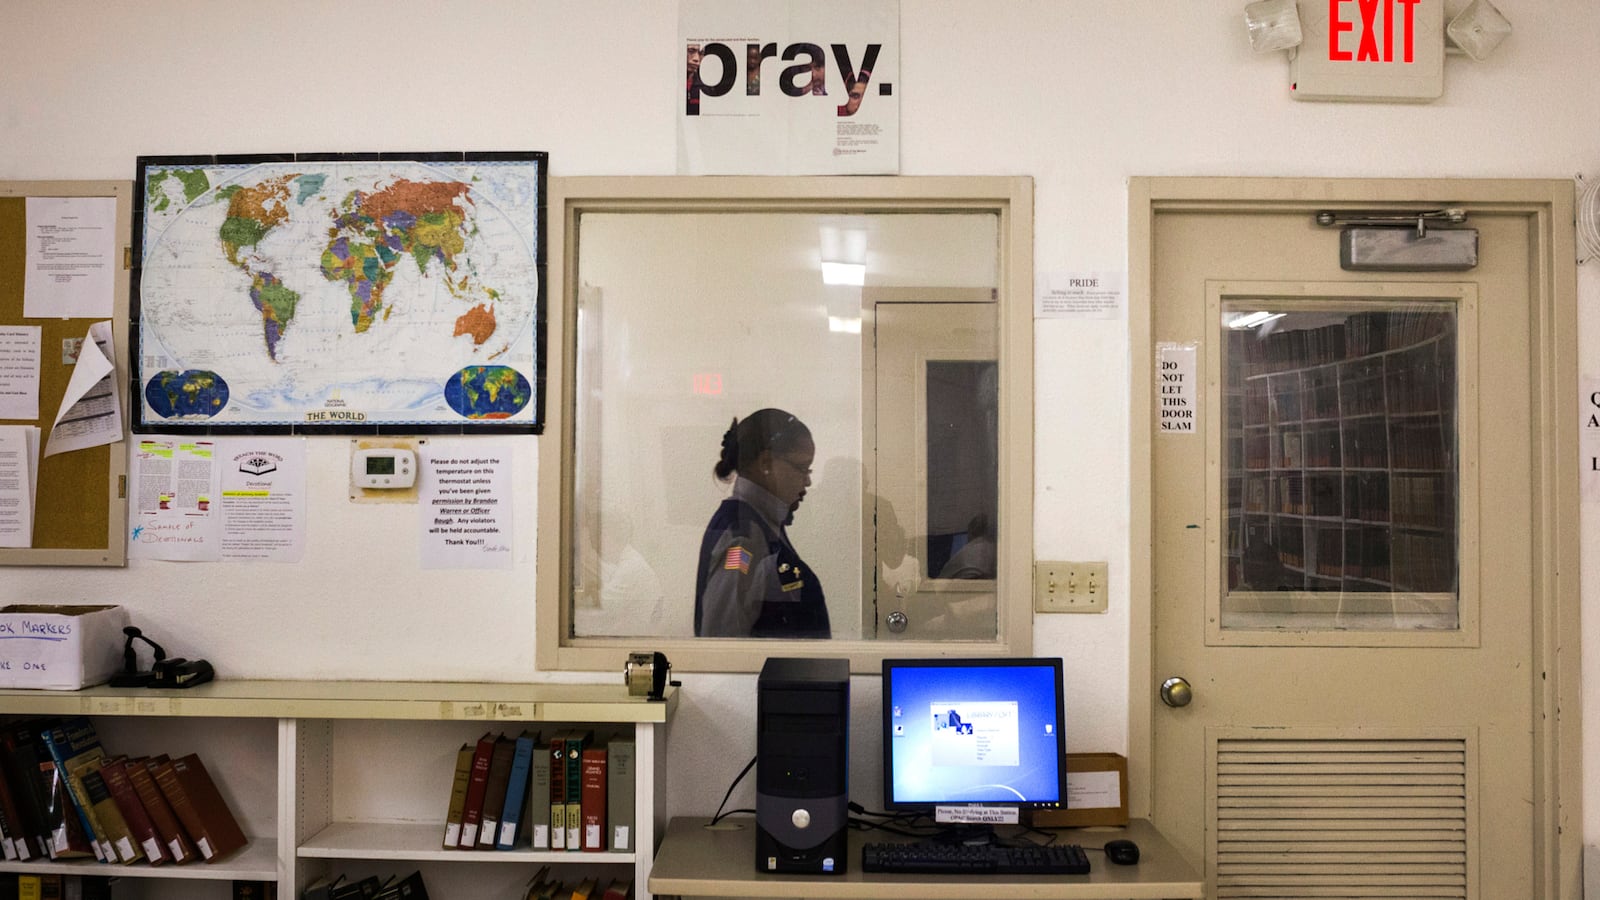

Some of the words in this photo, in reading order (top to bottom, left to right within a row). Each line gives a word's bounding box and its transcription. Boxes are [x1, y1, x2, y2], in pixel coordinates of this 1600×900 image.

[1328, 0, 1420, 63] EXIT
[686, 42, 893, 117] pray.
[1069, 279, 1100, 287] PRIDE
[1162, 361, 1178, 370] DO
[1162, 374, 1185, 382] NOT
[1162, 386, 1183, 394] LET
[1162, 398, 1187, 406] THIS
[306, 412, 327, 421] THE
[329, 411, 365, 421] WORLD
[1162, 410, 1193, 418] DOOR
[1161, 422, 1192, 431] SLAM
[21, 621, 72, 635] MARKERS
[23, 662, 47, 671] ONE
